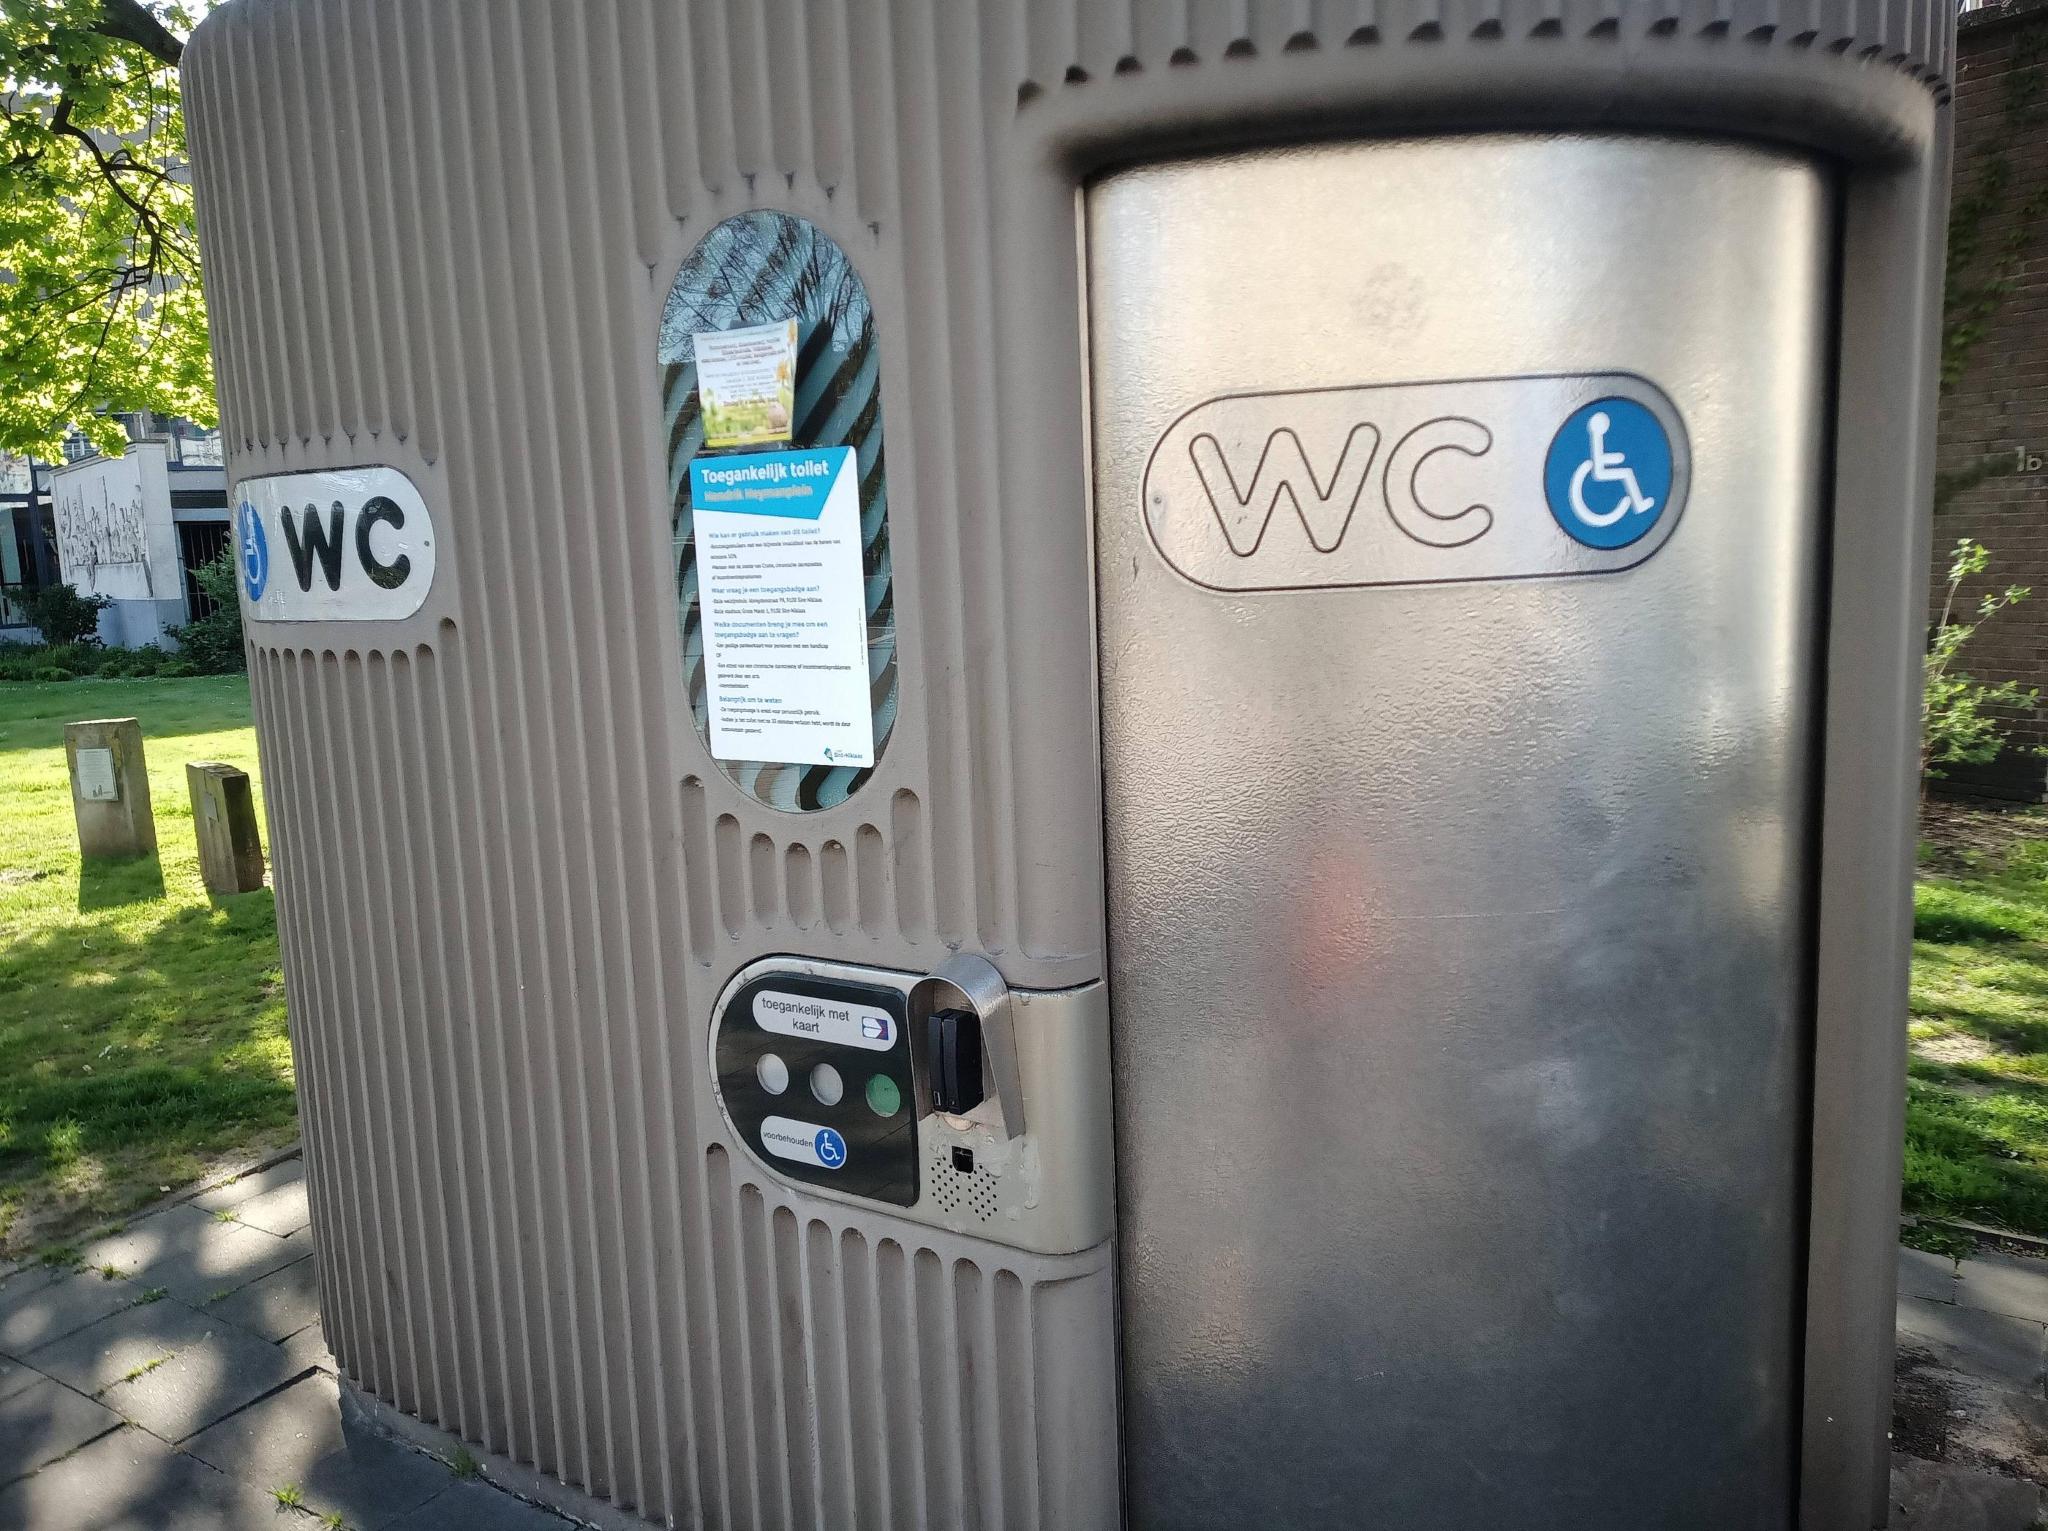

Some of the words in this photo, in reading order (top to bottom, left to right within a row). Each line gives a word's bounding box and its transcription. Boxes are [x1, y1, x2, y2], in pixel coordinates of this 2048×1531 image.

[701, 463, 787, 484] Toegankelijk
[790, 460, 828, 476] toilet
[1189, 416, 1493, 557] WC
[280, 496, 411, 592] WC
[738, 530, 759, 539] gebruik
[761, 997, 827, 1019] toegankelijk
[828, 1009, 850, 1022] met
[792, 1018, 820, 1034] kaart
[763, 1130, 814, 1148] voorbehouden
